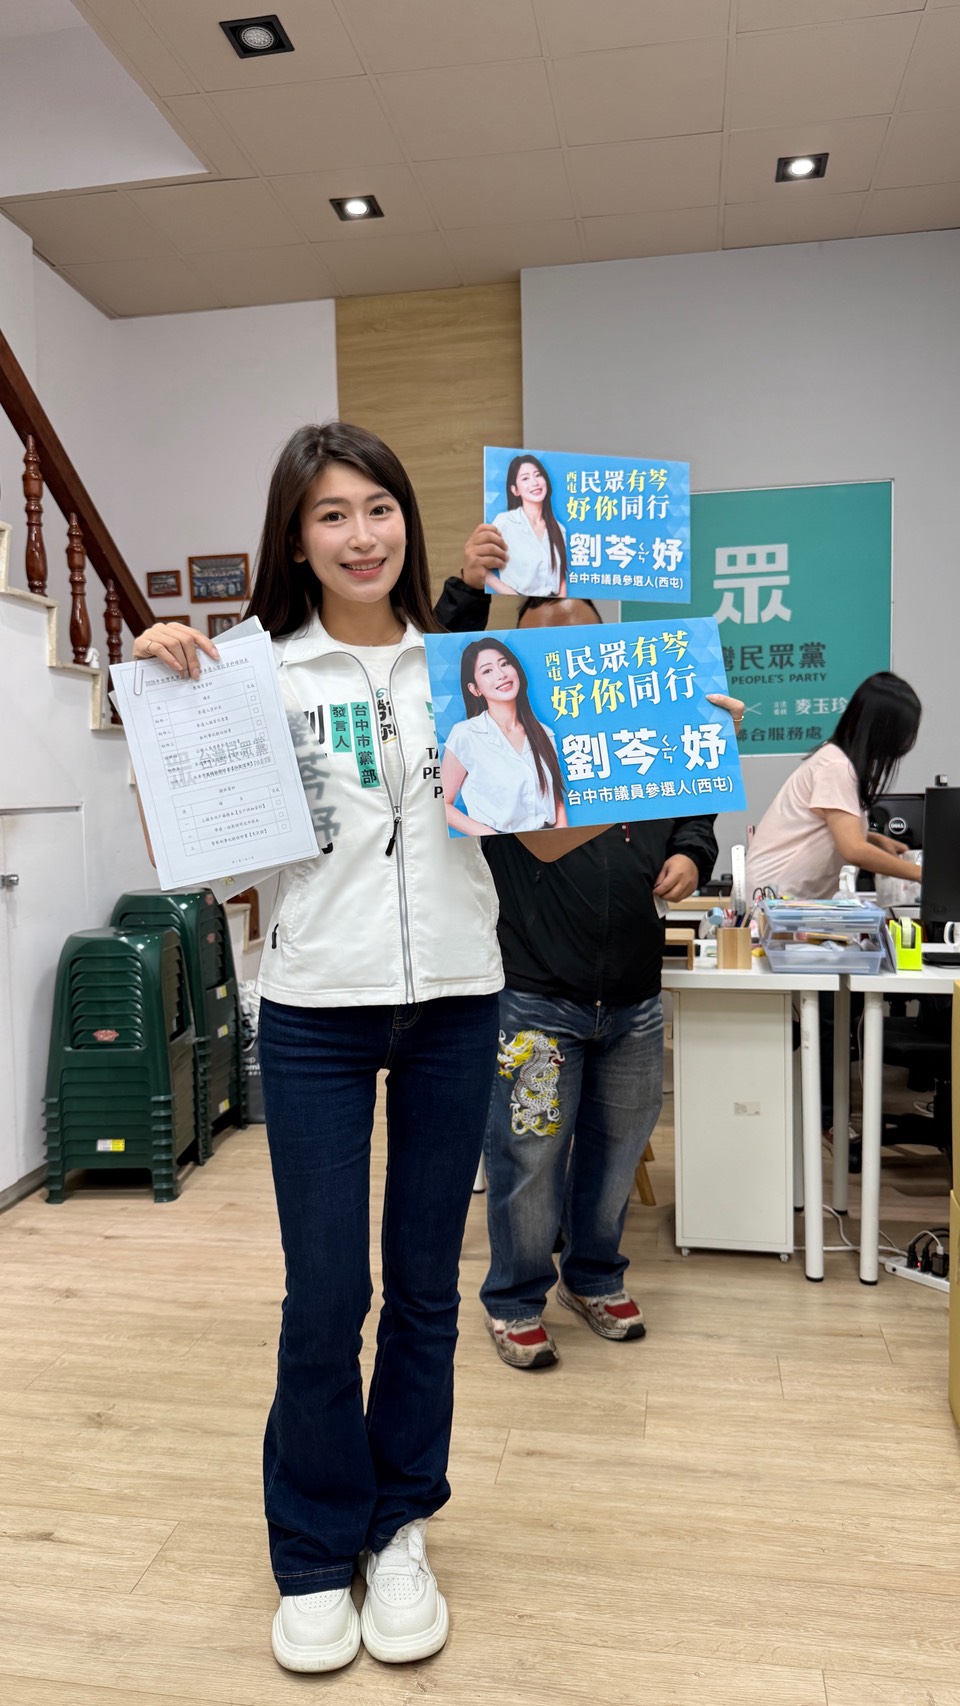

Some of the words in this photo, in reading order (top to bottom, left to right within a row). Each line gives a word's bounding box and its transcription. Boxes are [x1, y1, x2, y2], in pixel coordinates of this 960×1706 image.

[566, 471, 578, 494] 西屯
[566, 494, 670, 522] 妤你同行
[568, 571, 684, 590] 台中市議員參選人(西屯)
[545, 650, 564, 682] 西屯
[565, 630, 690, 680] 民眾有芩
[551, 664, 698, 722] 妤你同行
[731, 674, 784, 686] PEOPLE'S
[788, 672, 827, 683] PARTY
[795, 697, 849, 716] 麥玉珍
[332, 706, 350, 749] 發言人
[354, 704, 377, 785] 台中市黨部
[567, 776, 734, 806] 台中市議員參選人(西屯)
